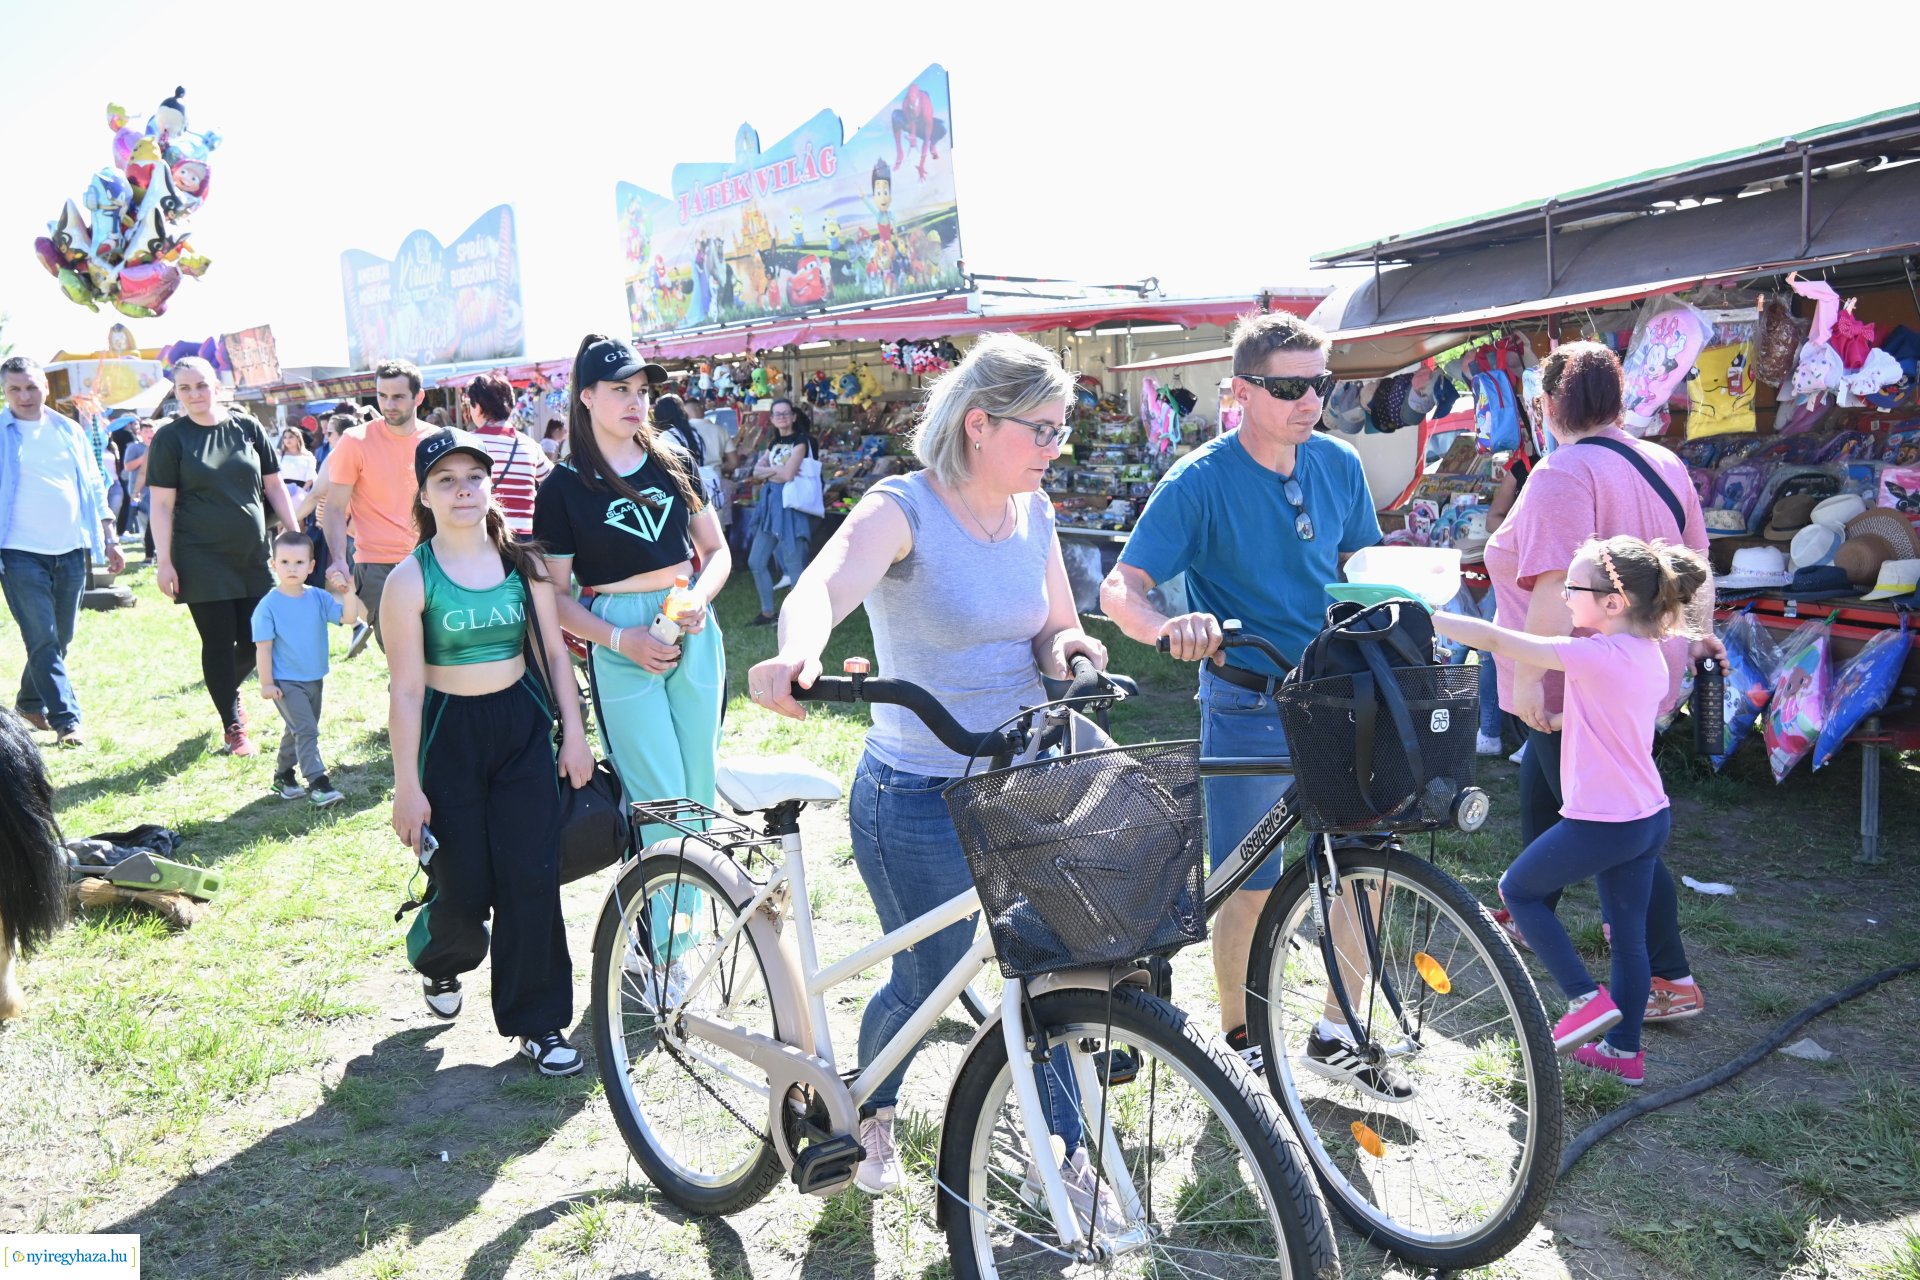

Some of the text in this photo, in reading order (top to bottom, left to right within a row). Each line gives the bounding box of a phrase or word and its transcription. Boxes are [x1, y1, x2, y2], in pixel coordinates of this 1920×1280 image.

[679, 142, 837, 224] JÁTÉK VILÁG
[450, 259, 497, 288] BURGONYA
[606, 502, 637, 518] GLAM
[442, 601, 526, 632] GLAM
[1309, 882, 1322, 923] BUDAPEST
